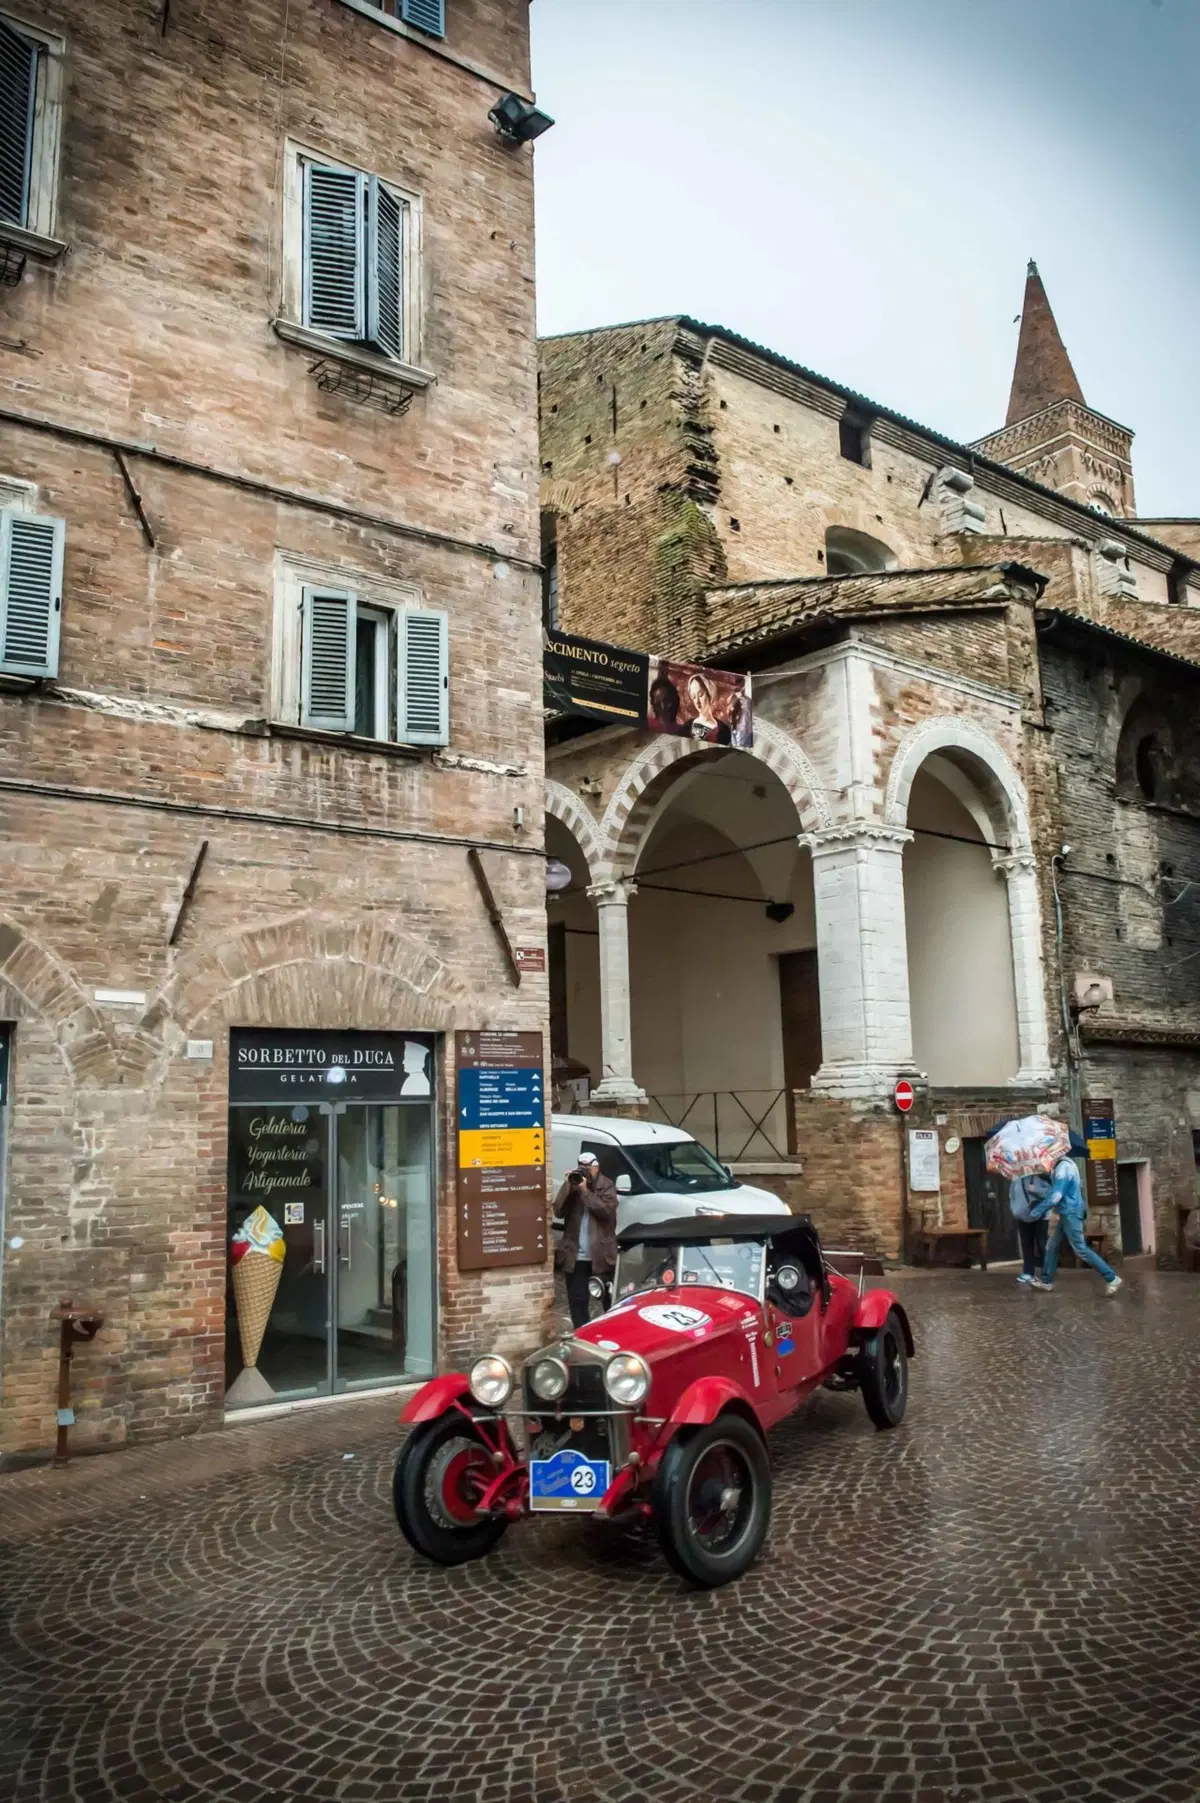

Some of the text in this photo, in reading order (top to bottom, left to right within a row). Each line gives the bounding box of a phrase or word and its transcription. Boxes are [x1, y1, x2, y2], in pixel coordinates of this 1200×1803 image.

[610, 659, 640, 673] segreto
[238, 1047, 394, 1065] SORBETTO DEL DUCA
[280, 1074, 357, 1083] GELATIA
[249, 1115, 307, 1140] Gelateria
[247, 1145, 308, 1168] Yogurteria
[241, 1168, 312, 1195] Artigianale
[661, 1311, 698, 1326] 23
[574, 1471, 594, 1488] 23
